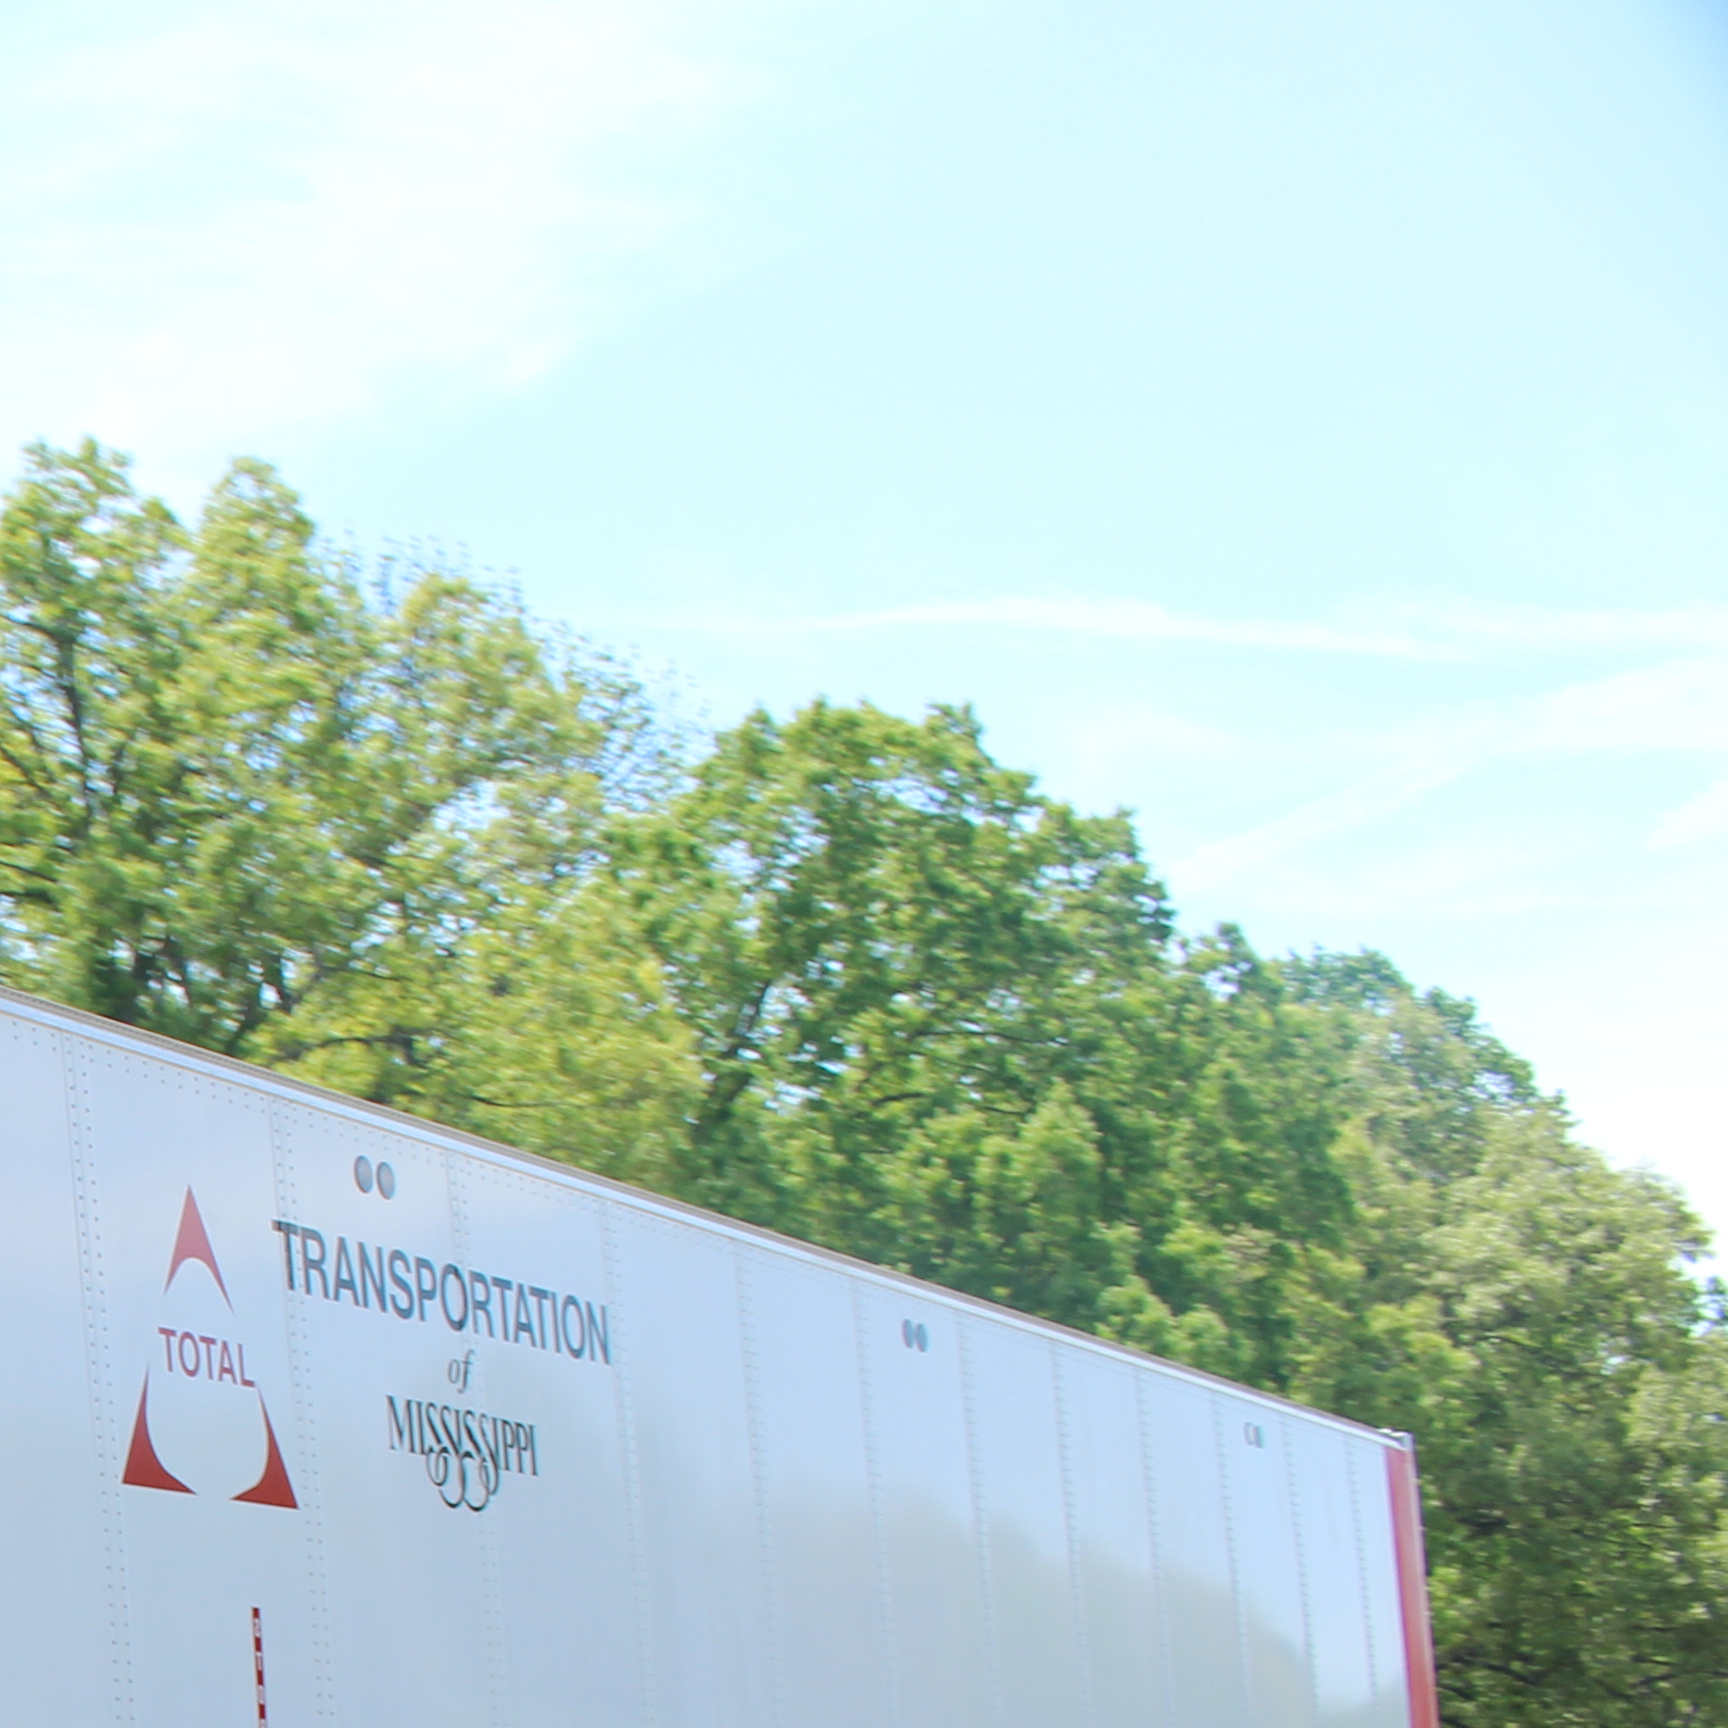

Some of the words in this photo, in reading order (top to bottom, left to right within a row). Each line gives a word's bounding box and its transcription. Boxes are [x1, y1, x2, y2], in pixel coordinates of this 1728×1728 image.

[270, 1218, 611, 1366] TRANSPORTATION
[157, 1326, 256, 1389] TOTAL
[447, 1348, 476, 1394] of
[385, 1394, 539, 1511] MISSISSIPPI
